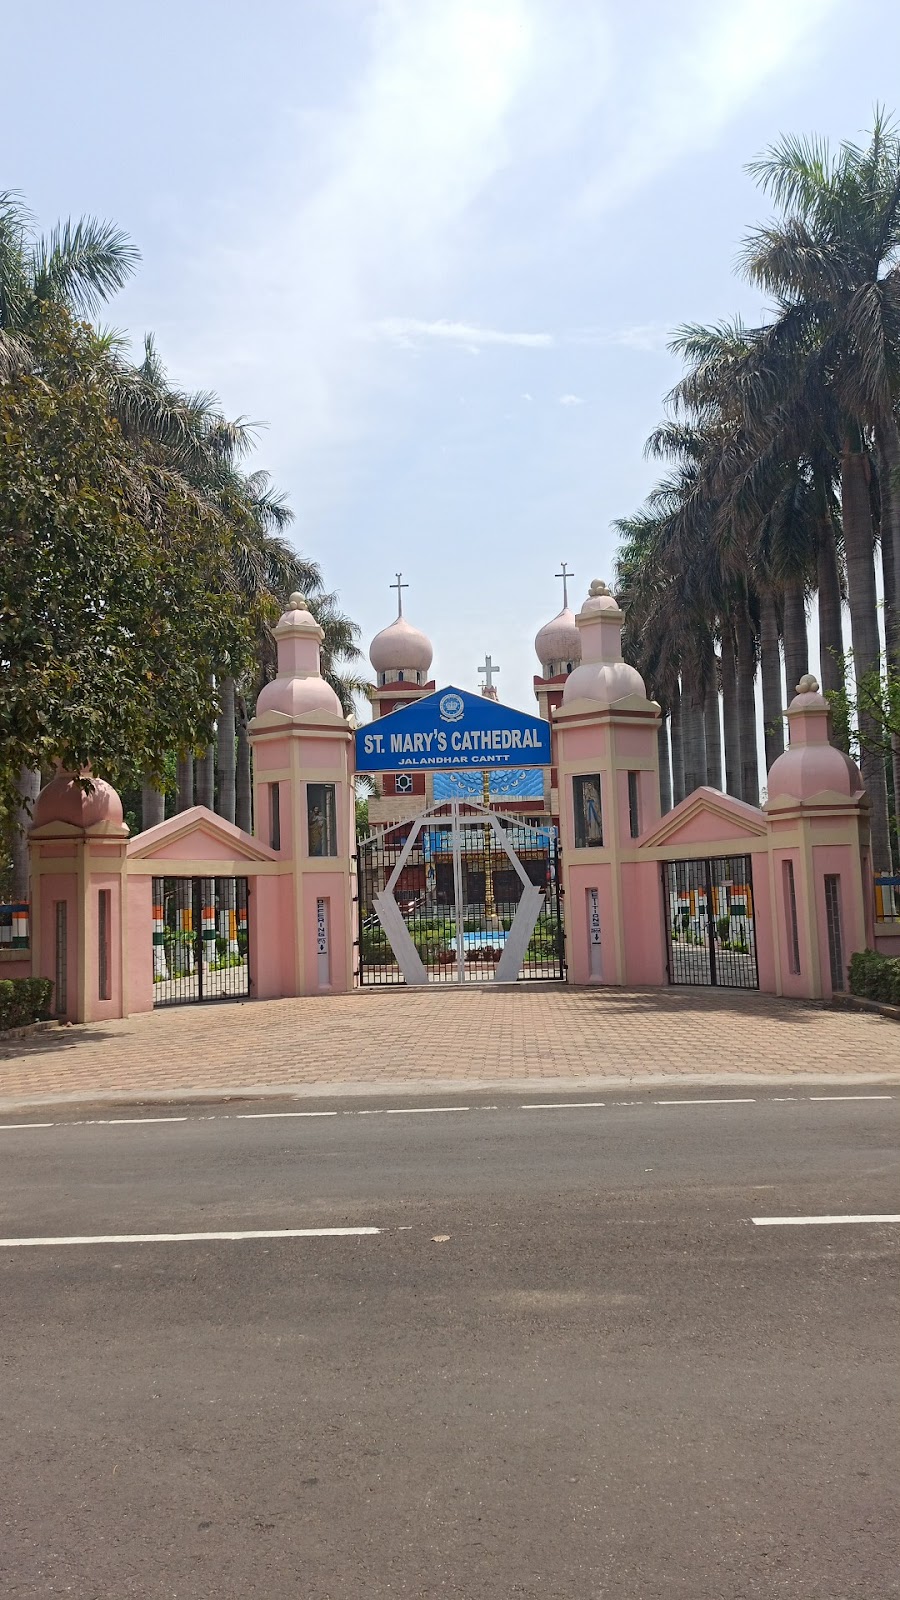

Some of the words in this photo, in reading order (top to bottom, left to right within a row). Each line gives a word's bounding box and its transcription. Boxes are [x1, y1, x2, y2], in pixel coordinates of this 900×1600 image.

[364, 734, 386, 754] ST.
[391, 729, 447, 753] MARY'S
[451, 729, 542, 751] CATHEDRAL
[398, 756, 468, 765] JALANDHAR
[471, 754, 510, 763] CANTT
